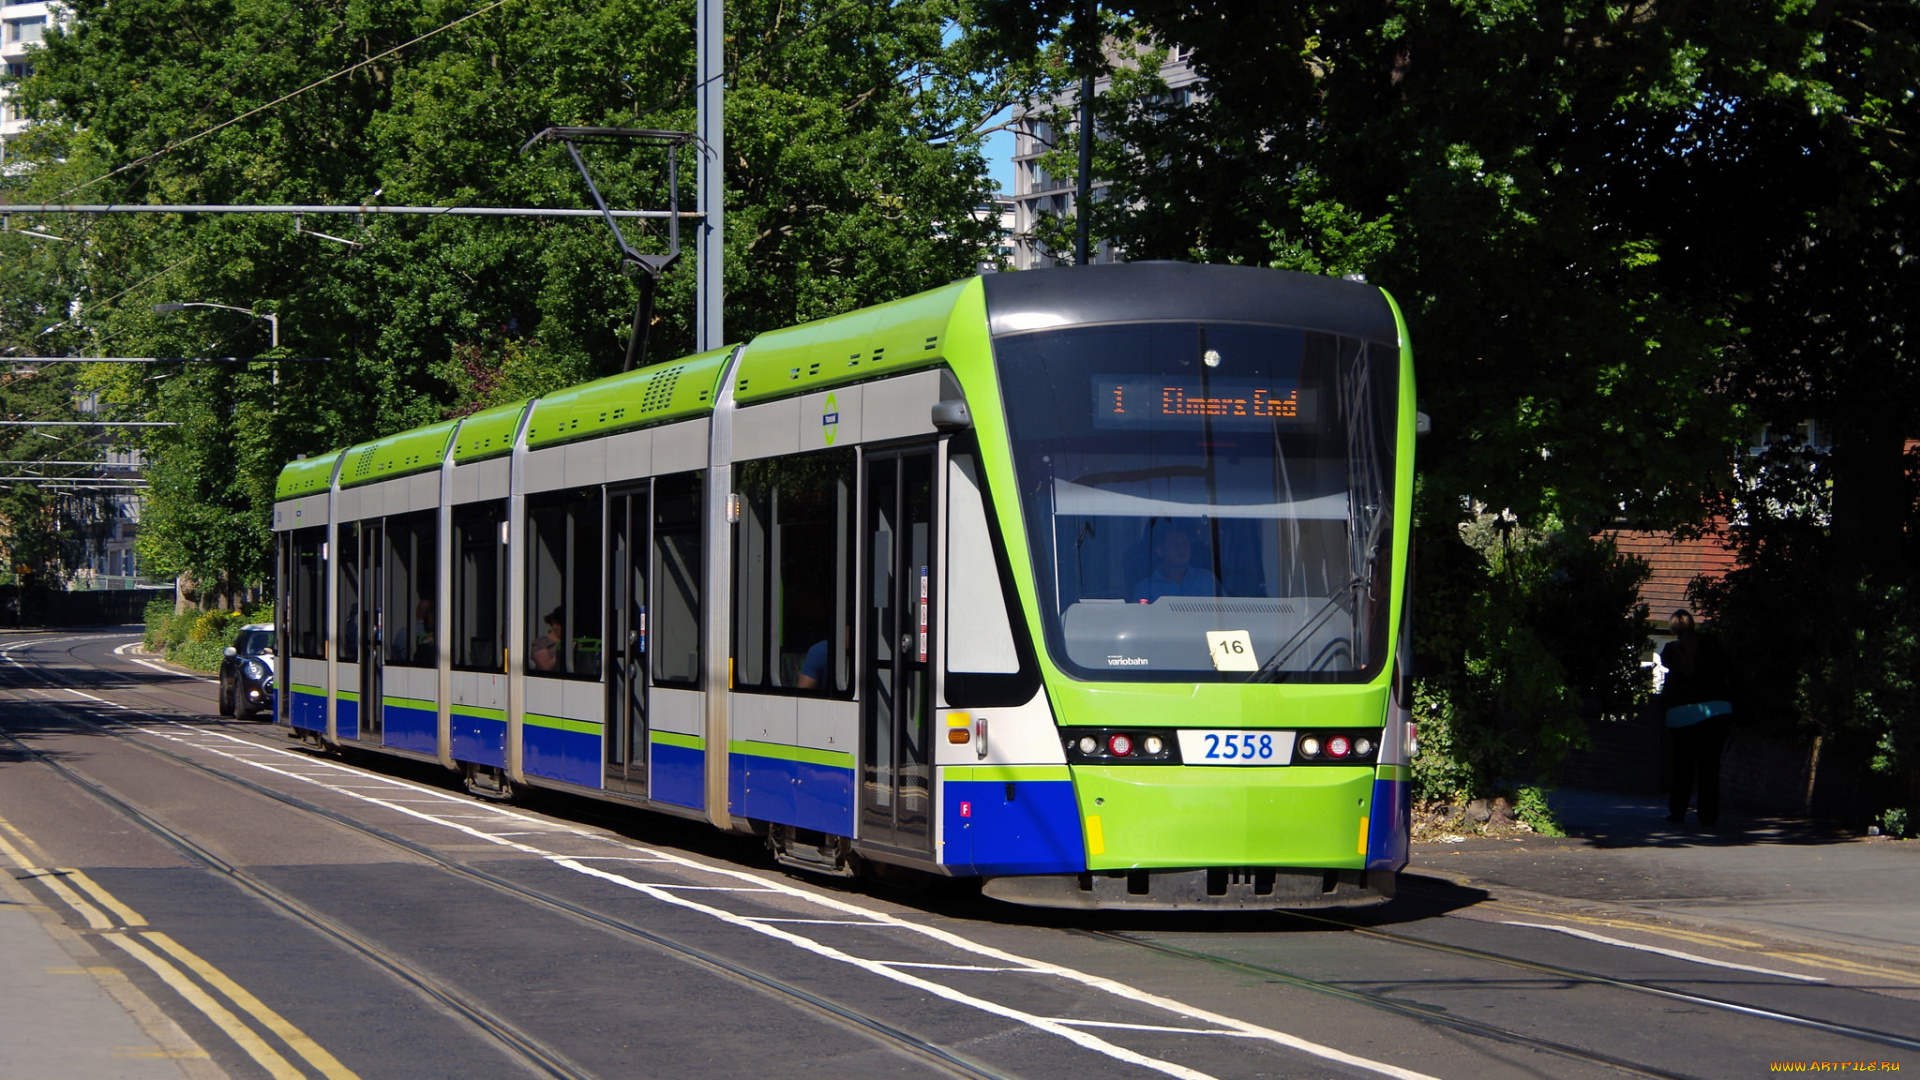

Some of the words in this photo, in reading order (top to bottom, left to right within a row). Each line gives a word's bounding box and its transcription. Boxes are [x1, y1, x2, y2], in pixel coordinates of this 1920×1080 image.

[1113, 386, 1125, 413] 1
[1163, 387, 1247, 415] Elmers
[1254, 389, 1297, 416] End
[1219, 640, 1244, 654] 16
[1107, 657, 1148, 666] variobahn
[1204, 734, 1273, 759] 2558
